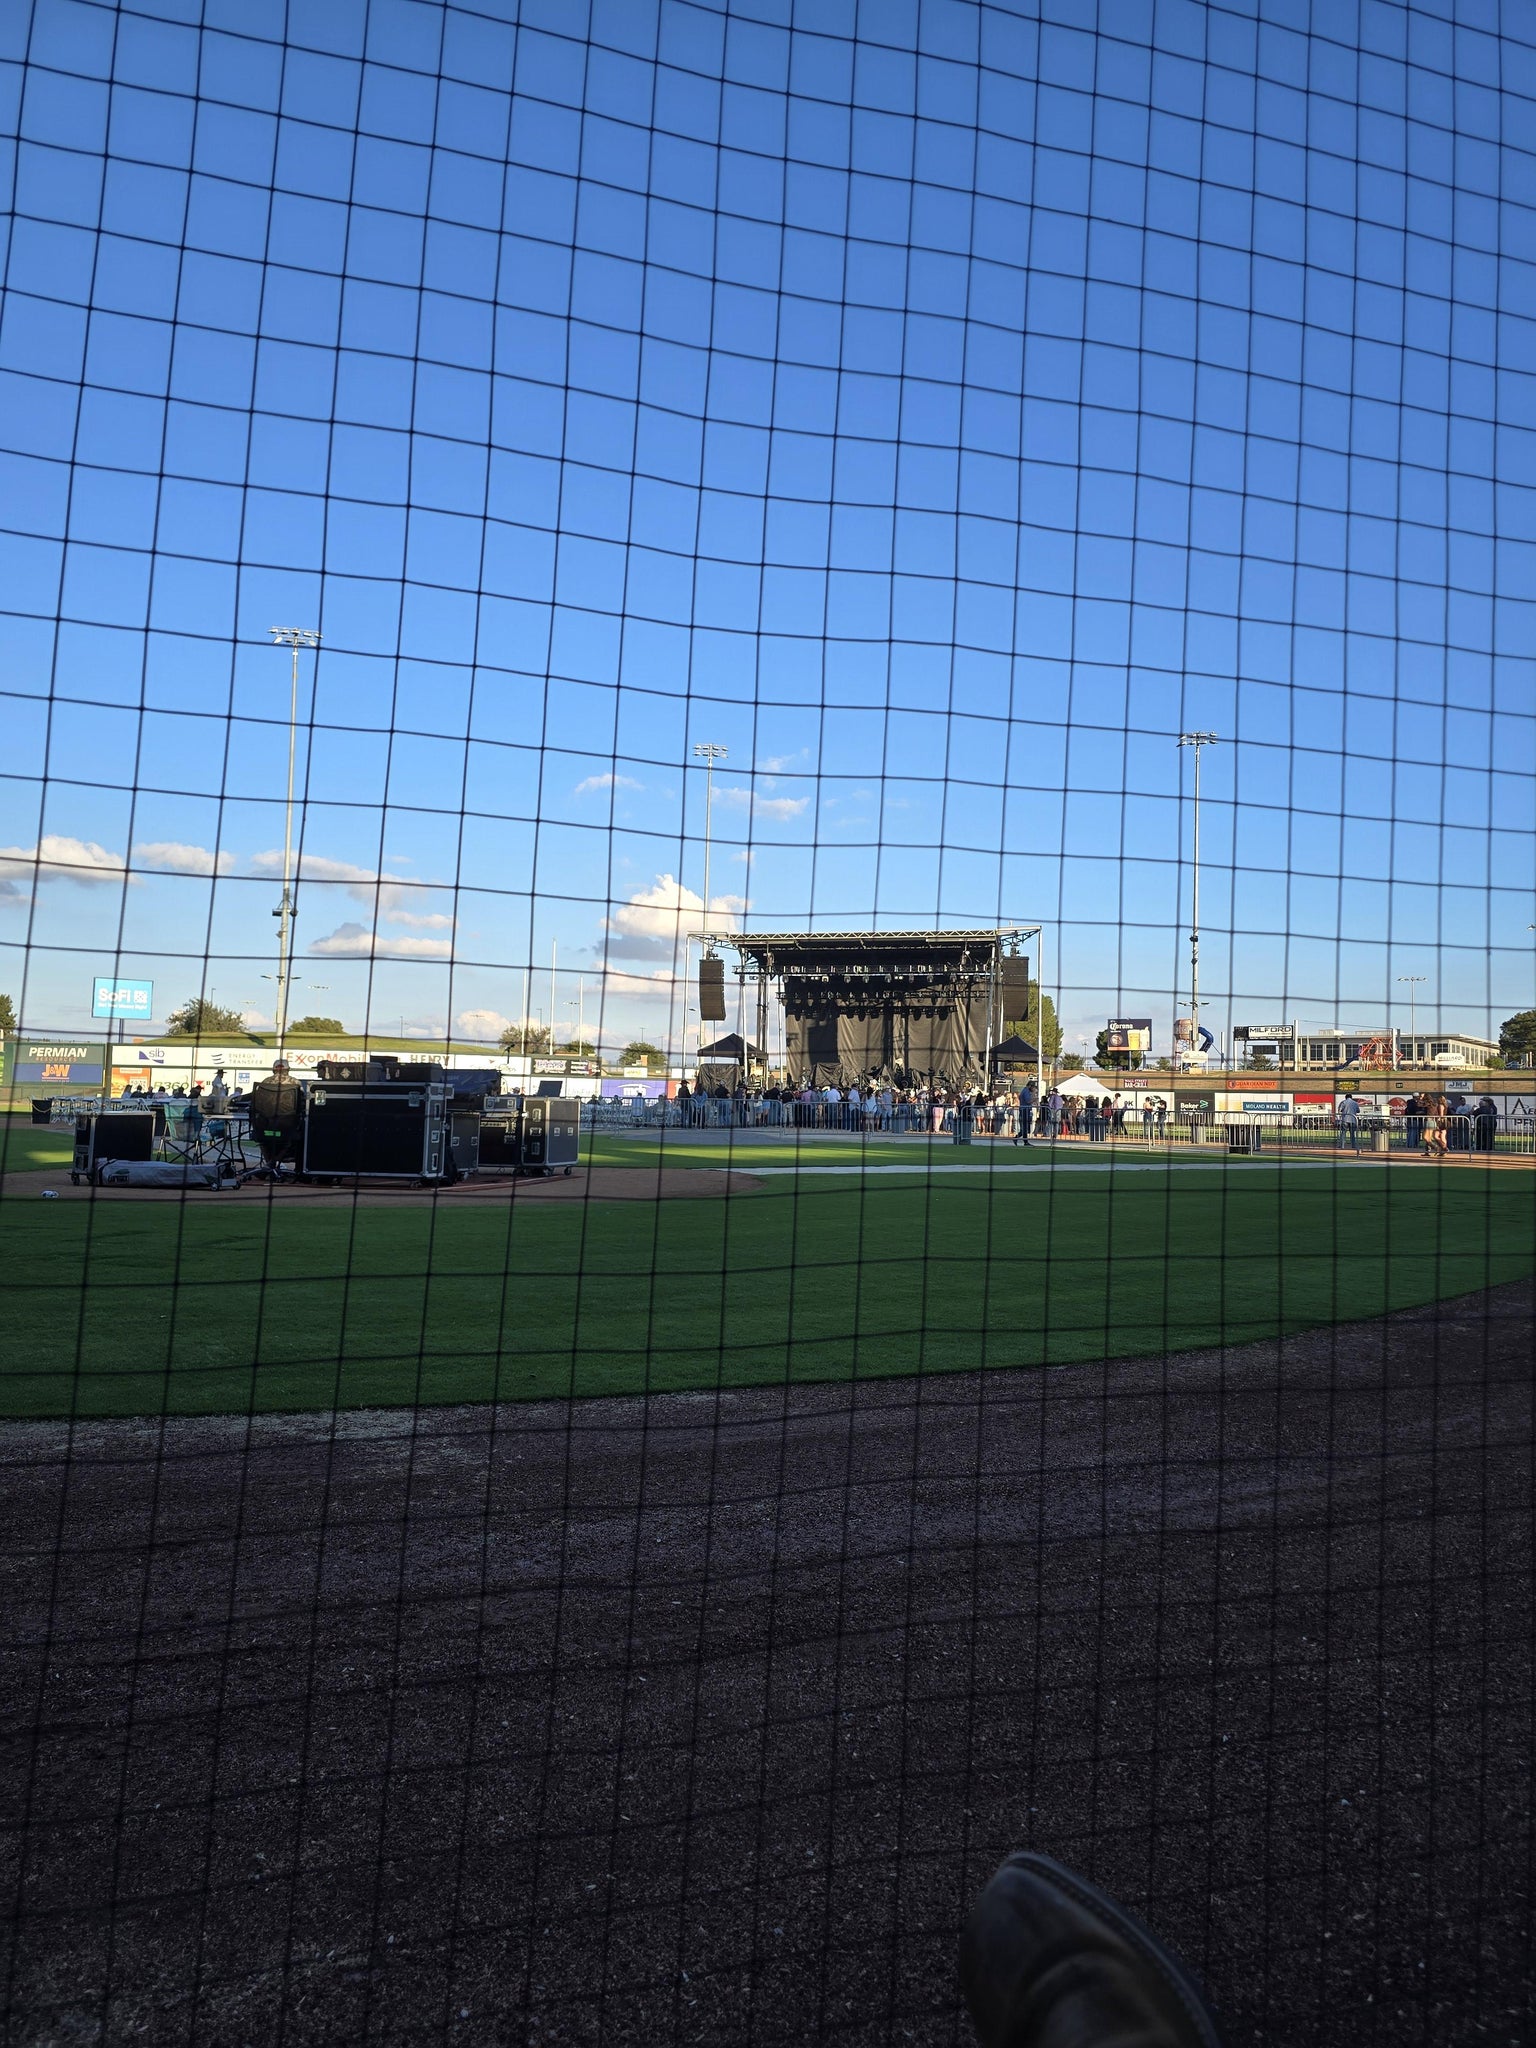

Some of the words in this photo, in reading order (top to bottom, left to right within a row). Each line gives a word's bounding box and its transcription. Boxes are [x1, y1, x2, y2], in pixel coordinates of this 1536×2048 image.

[98, 988, 131, 1003] SoFi
[29, 1047, 87, 1058] PERMIAN
[149, 1048, 165, 1058] slb
[286, 1052, 366, 1066] ExxonMobil
[410, 1054, 449, 1067] HENRY
[42, 1064, 71, 1077] J&W
